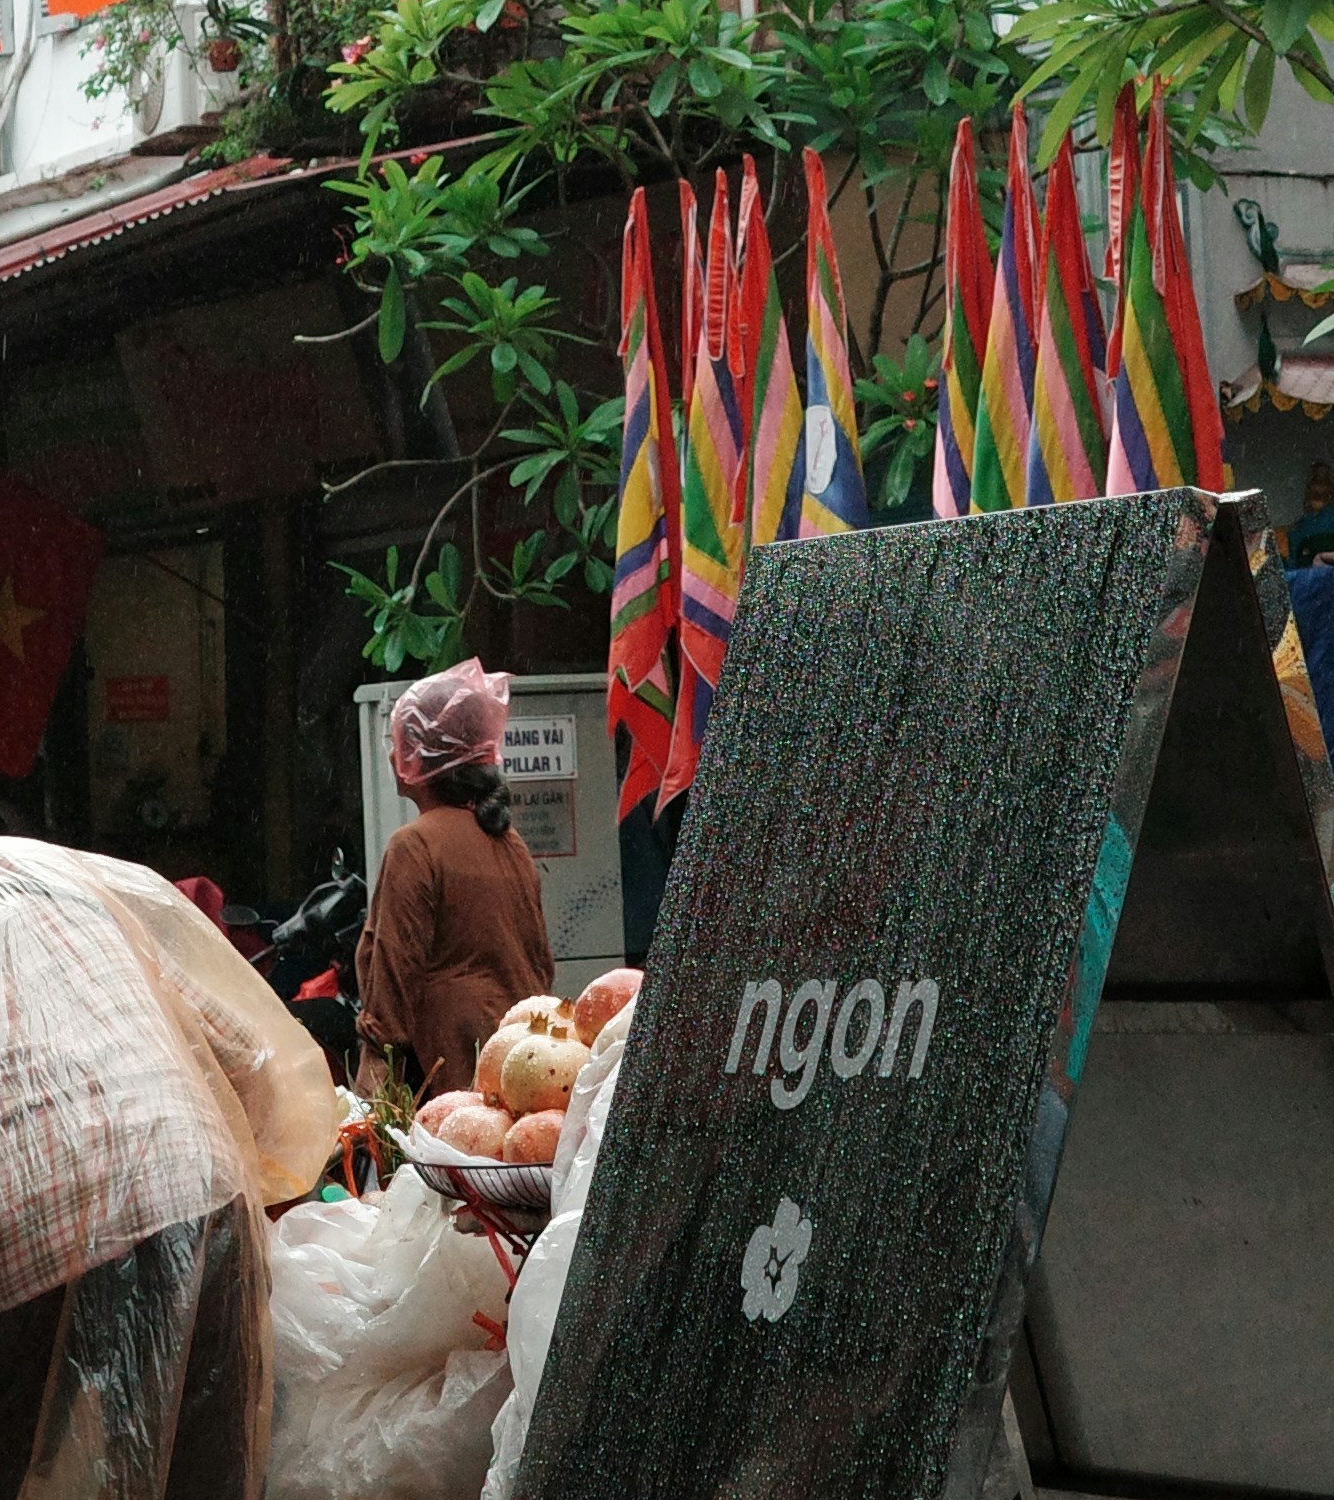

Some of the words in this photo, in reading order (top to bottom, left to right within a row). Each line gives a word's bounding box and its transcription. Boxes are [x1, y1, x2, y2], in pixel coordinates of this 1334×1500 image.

[503, 757, 550, 774] PILLAR
[555, 756, 561, 771] 1
[724, 979, 940, 1110] ngon
